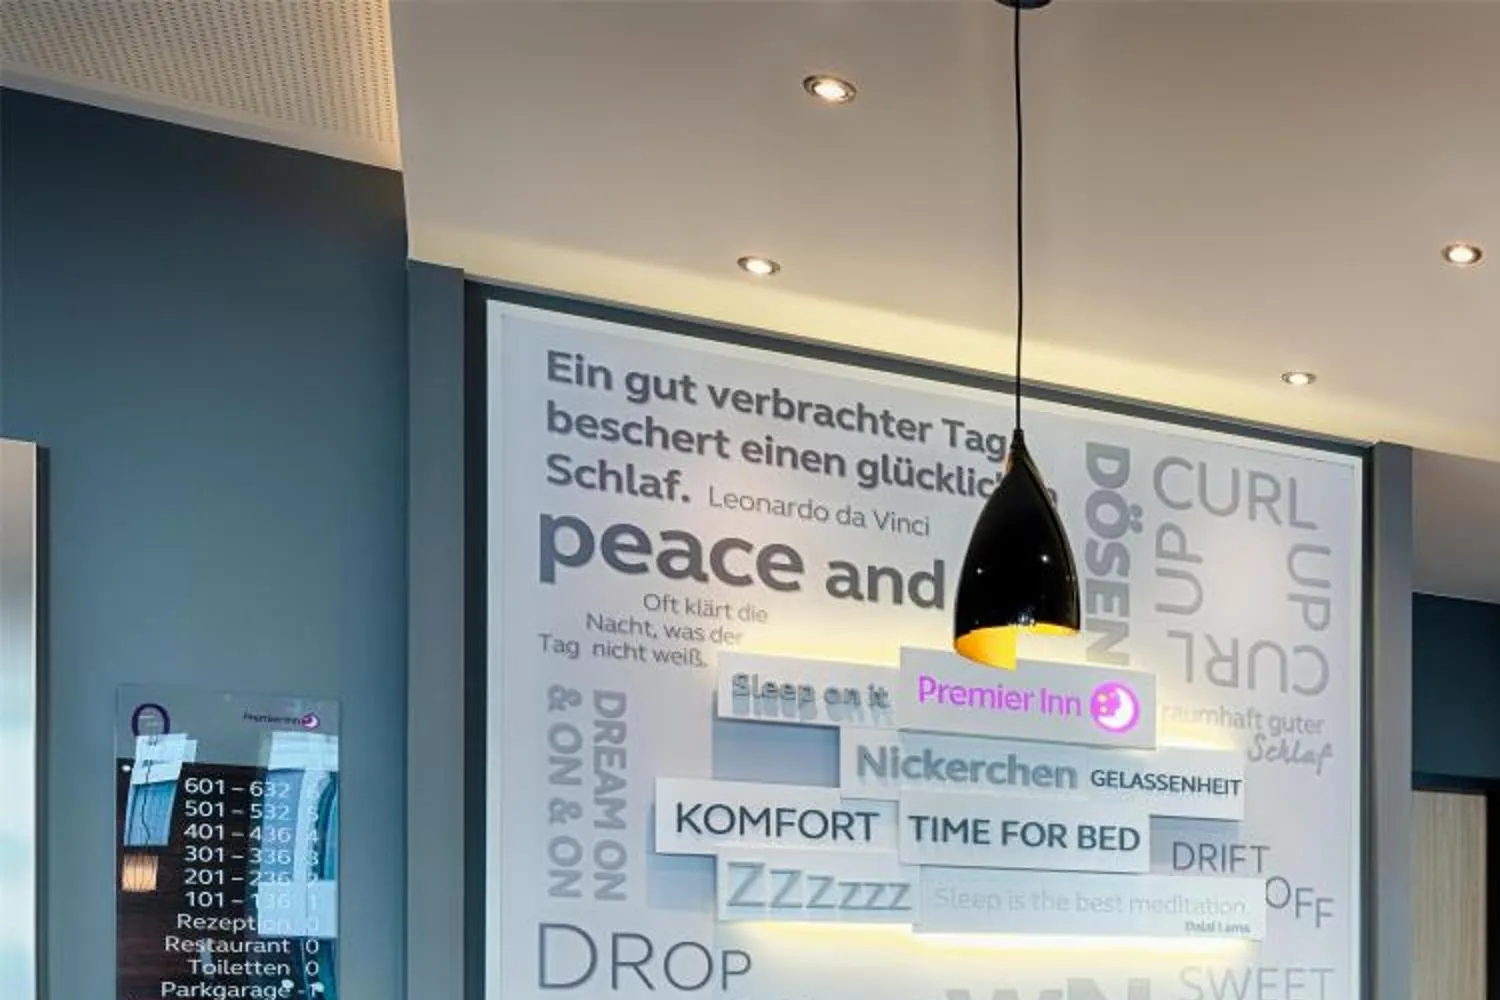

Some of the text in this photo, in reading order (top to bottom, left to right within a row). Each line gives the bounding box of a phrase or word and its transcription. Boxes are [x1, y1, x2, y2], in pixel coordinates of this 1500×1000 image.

[547, 350, 1008, 464] Ein gut verbrachter Tag
[547, 401, 1058, 508] beschert einen glücklic
[546, 454, 930, 537] Schlaf. Leonardo da Vinci
[1153, 456, 1319, 531] CURL
[538, 512, 946, 610] peace and
[1085, 442, 1142, 666] DÖSEN
[1155, 523, 1203, 616] UP
[1286, 542, 1332, 631] UP
[586, 612, 744, 647] Nacht, was der
[643, 593, 769, 624] Oft klärt die
[538, 633, 708, 668] Tag nicht weiß.
[1167, 630, 1330, 696] CURL
[731, 673, 890, 709] Sleep on it
[918, 675, 1082, 718] Premier Inn
[1163, 704, 1326, 739] raumhaft guter
[856, 745, 1244, 798] Nickerchen GELASSENHEIT
[1246, 733, 1334, 776] Schlaf
[185, 777, 225, 795] 601
[250, 781, 290, 798] 632
[548, 684, 583, 899] & ON & ON
[593, 690, 627, 901] DREAM ON
[185, 800, 225, 818] 501
[250, 804, 290, 822] 532
[676, 801, 880, 843] KOMFORT
[184, 823, 225, 841] 401
[249, 826, 291, 843] 436
[908, 814, 1141, 852] TIME FOR BED
[185, 846, 225, 864] 301
[249, 849, 291, 867] 336
[1172, 841, 1271, 874] DRIFT
[185, 868, 225, 886] 201
[249, 871, 291, 888] 236
[188, 891, 224, 908] 101
[1265, 876, 1334, 930] OFF
[165, 935, 320, 954] Restaurant 0
[538, 922, 752, 991] DROP
[188, 958, 320, 977] Toiletten 0
